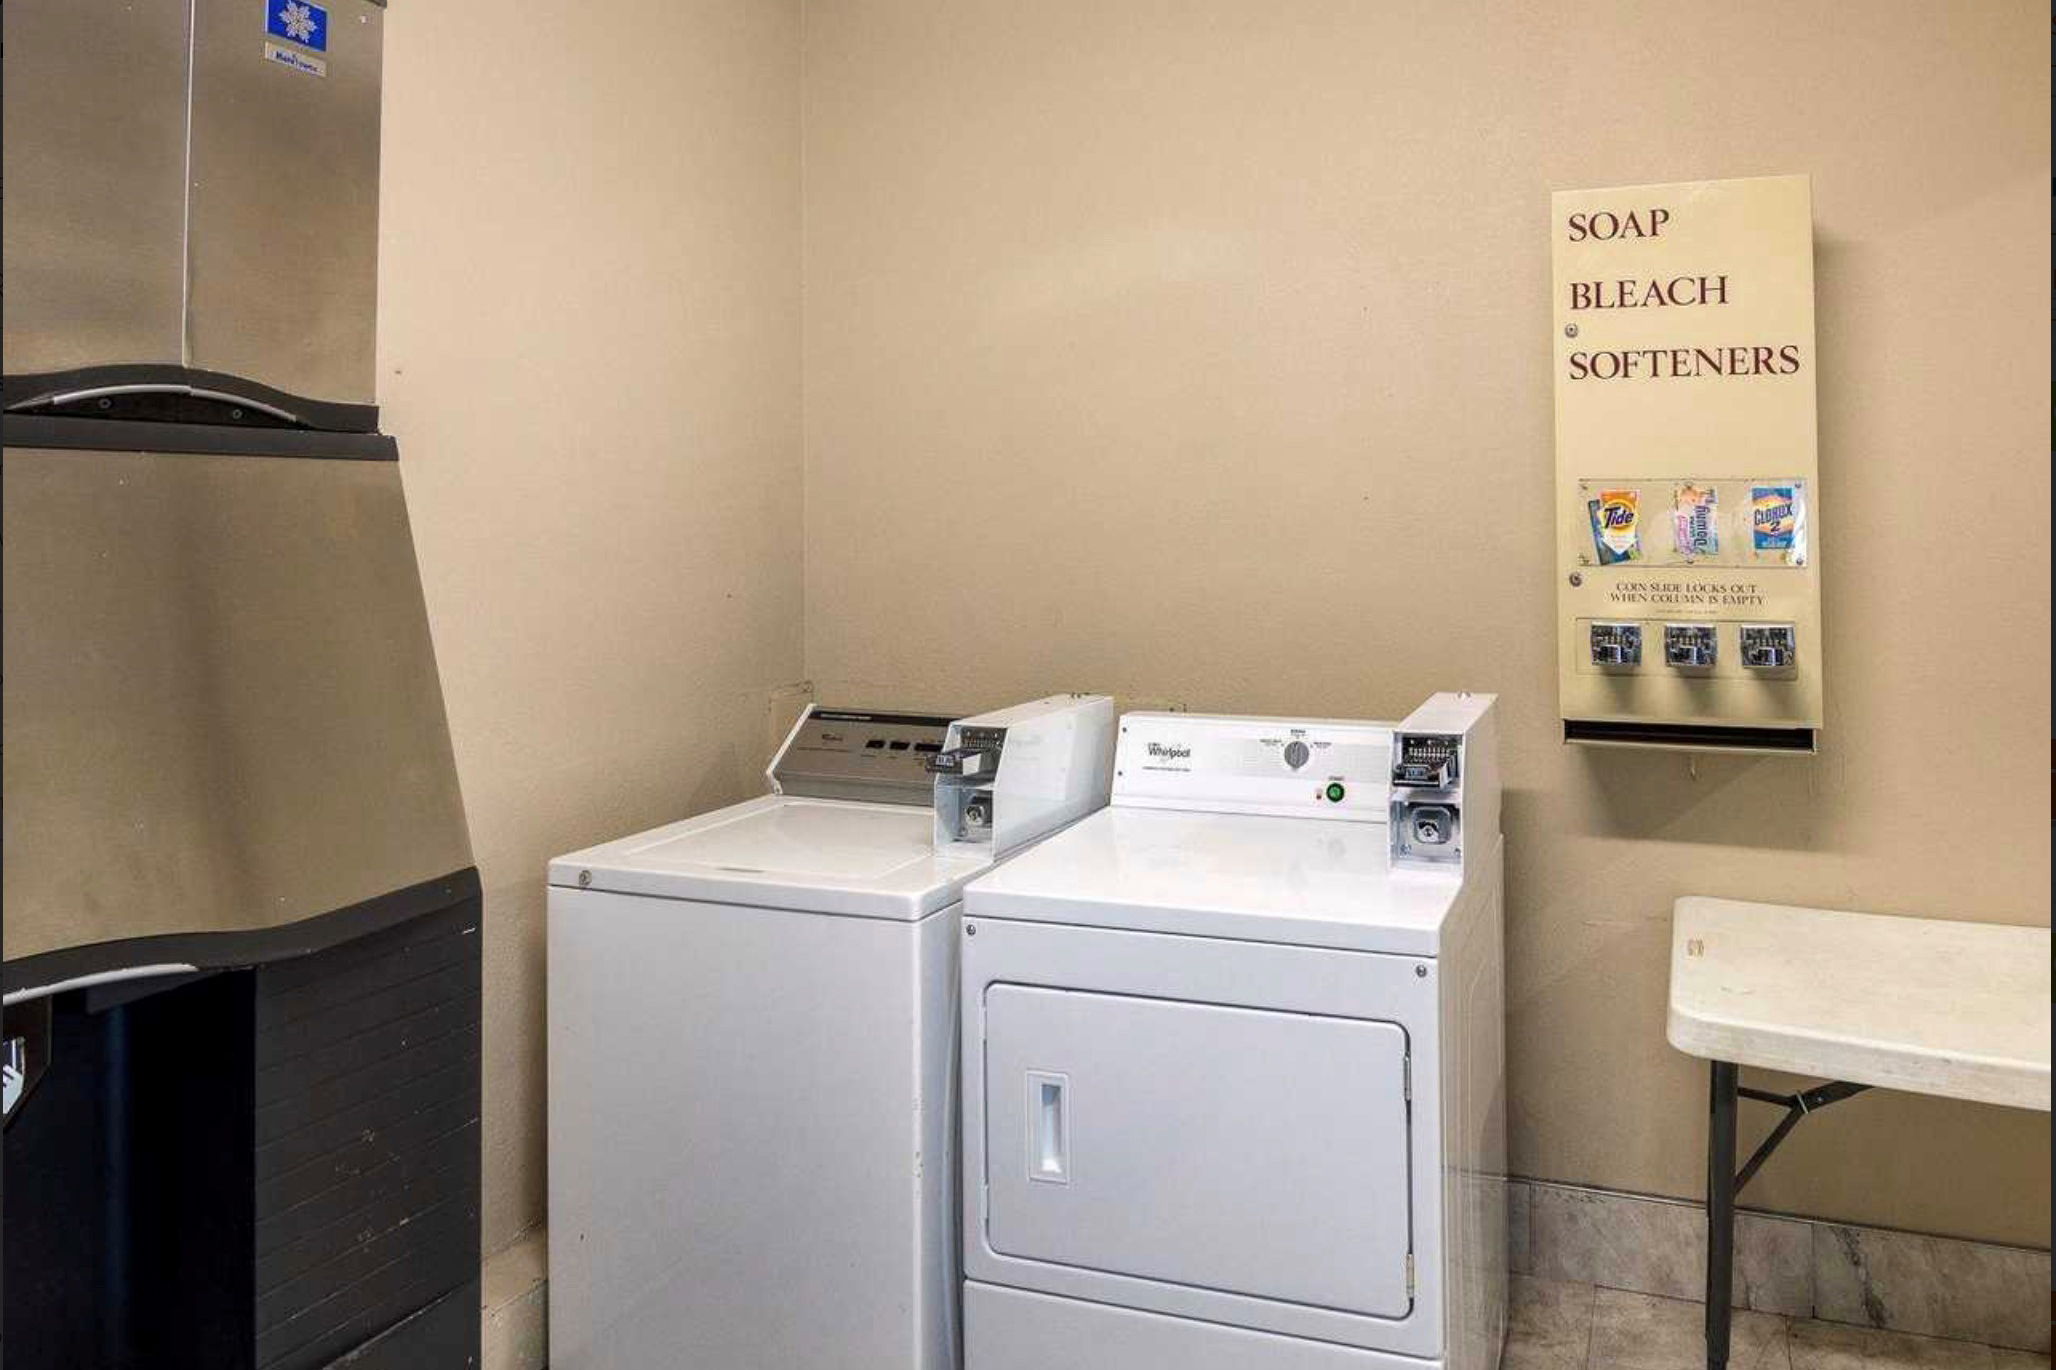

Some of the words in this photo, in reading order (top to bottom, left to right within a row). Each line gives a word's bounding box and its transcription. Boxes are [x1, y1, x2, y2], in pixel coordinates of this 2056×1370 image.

[1568, 208, 1670, 242] SOAP
[1570, 275, 1730, 310] BLEACH
[1568, 344, 1800, 381] SOFTENERS
[1604, 506, 1635, 529] Tide
[1694, 505, 1711, 546] Downy
[1610, 593, 1647, 602] WHEN
[1651, 593, 1702, 603] COLUMN
[1708, 594, 1719, 604] IS
[1722, 594, 1764, 605] EMPTY
[1616, 583, 1647, 592] COIN
[1650, 583, 1681, 592] SLIDE
[1685, 583, 1727, 593] LOCKS
[1730, 584, 1757, 593] OUT
[1148, 746, 1191, 760] Whirlpool
